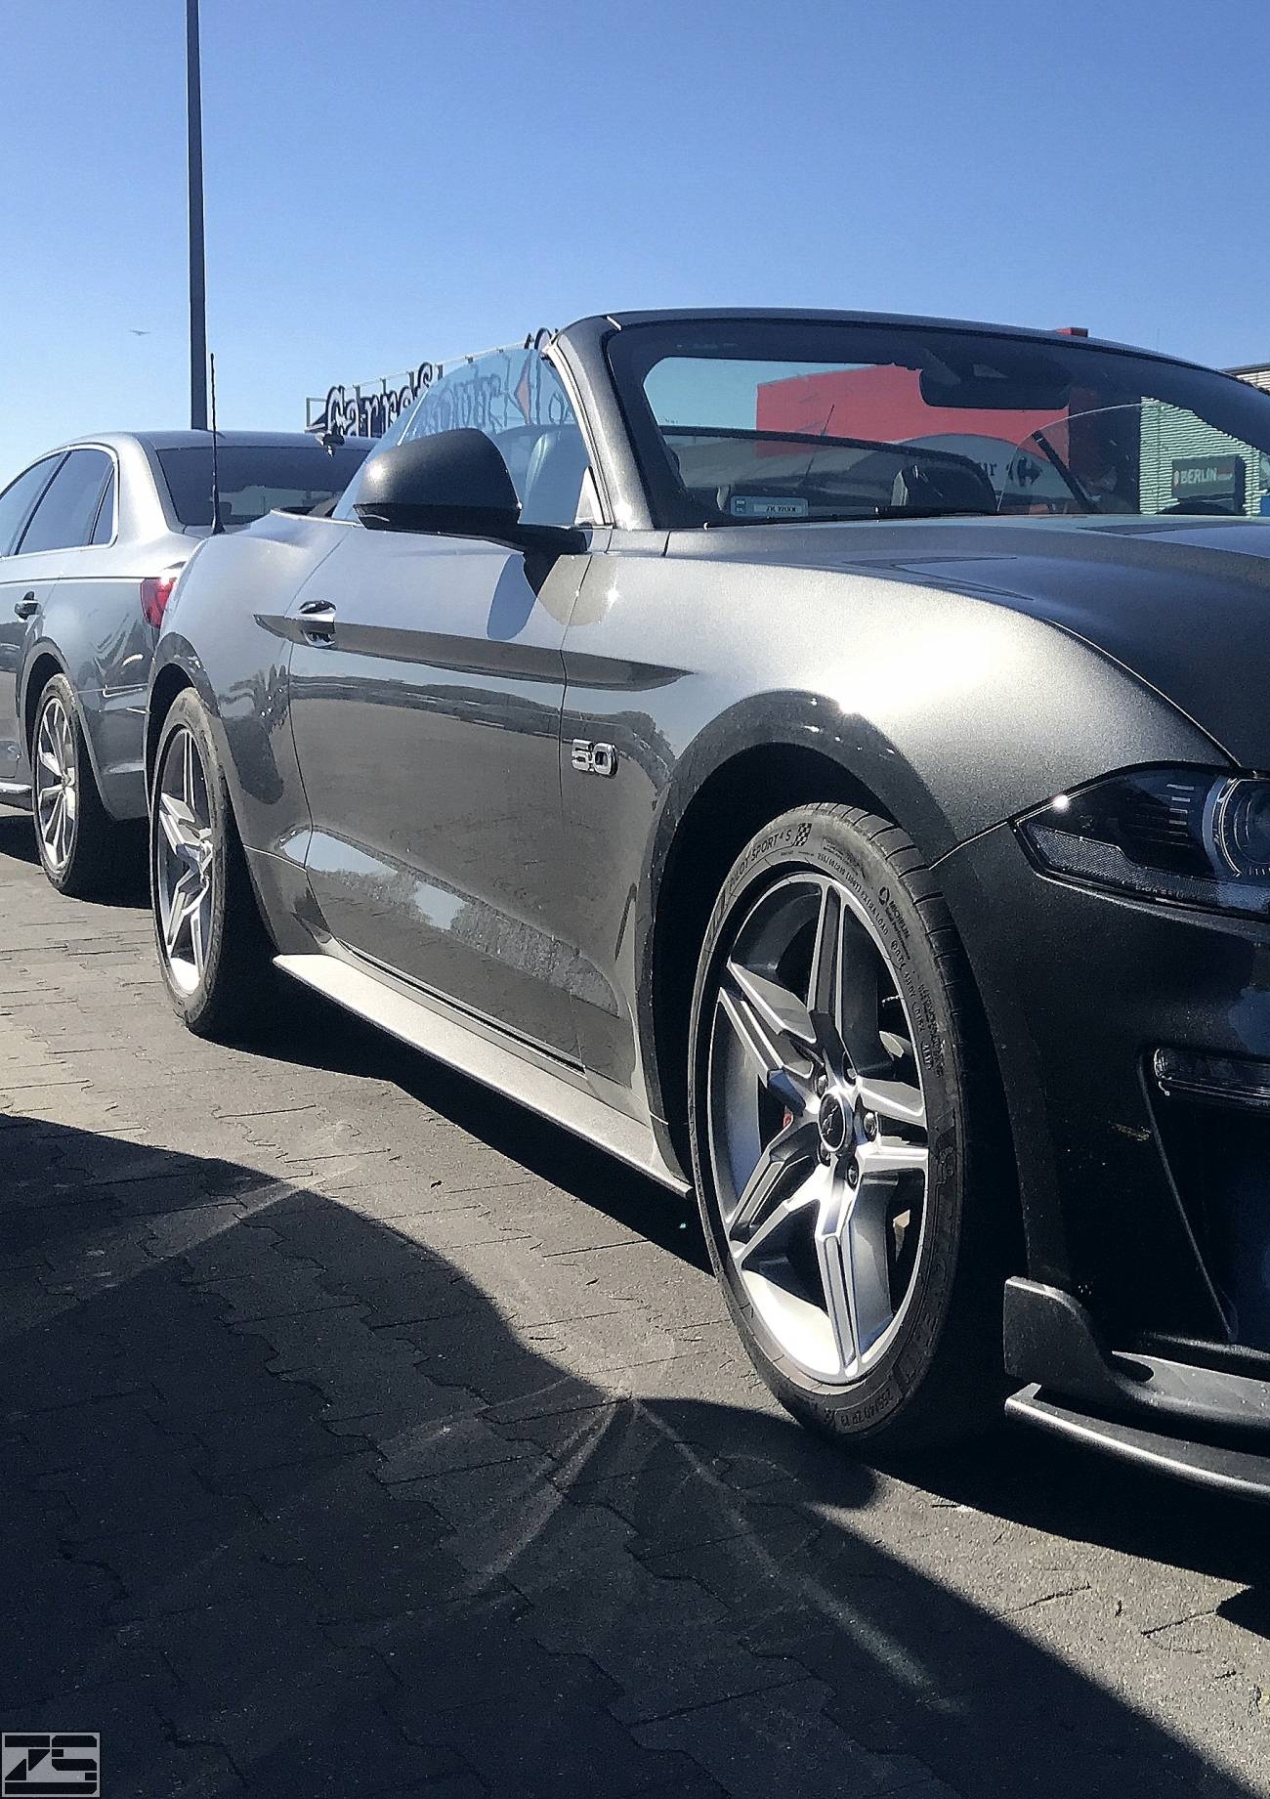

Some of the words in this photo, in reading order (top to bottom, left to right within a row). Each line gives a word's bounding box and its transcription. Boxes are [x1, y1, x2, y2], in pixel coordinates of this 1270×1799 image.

[1180, 467, 1218, 485] BERLIN
[750, 834, 781, 861] SPORT
[889, 900, 911, 939] MICHELIN
